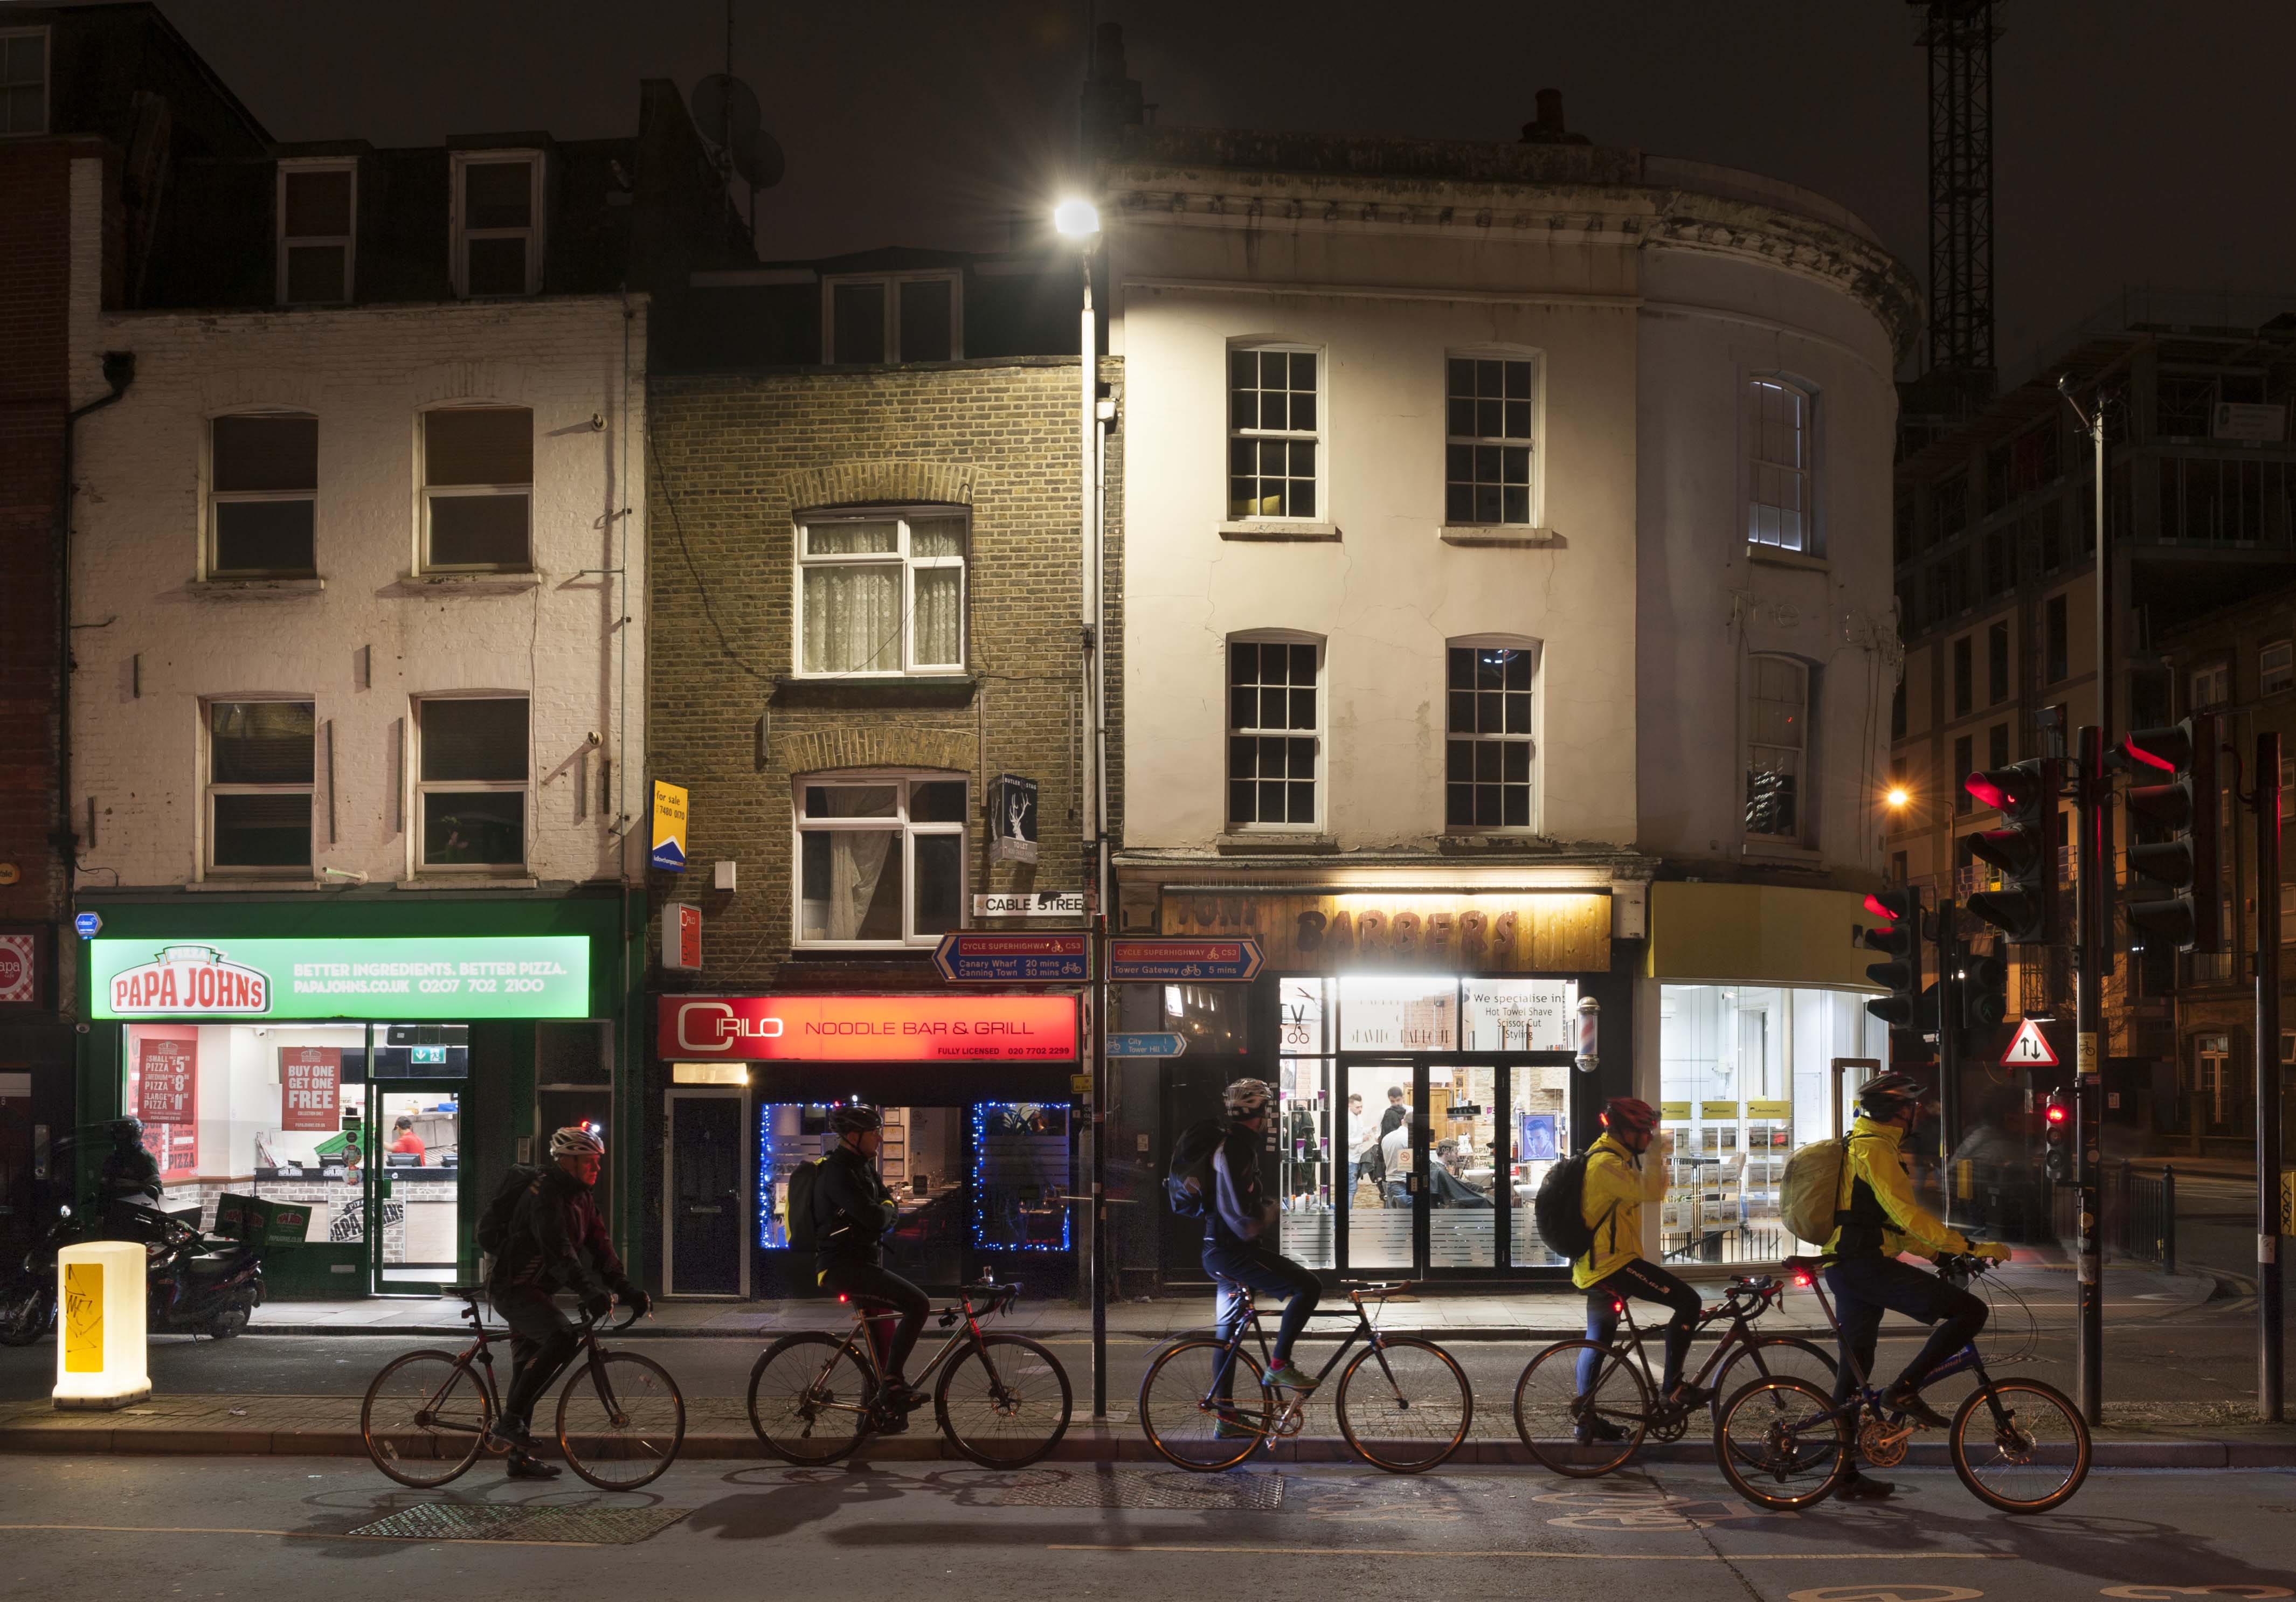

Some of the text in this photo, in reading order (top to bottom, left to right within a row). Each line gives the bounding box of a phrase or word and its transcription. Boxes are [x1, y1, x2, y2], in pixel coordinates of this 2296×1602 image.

[1005, 778, 1020, 786] BUTLER
[656, 790, 680, 806] for sale
[660, 805, 684, 820] 7480 0170
[986, 898, 1083, 911] CABLE STREE
[1297, 910, 1518, 954] BARBERS
[293, 962, 568, 976] BETTER INGREDIENTS. BETTER PIZZA.
[959, 960, 989, 969] Canary
[992, 960, 1018, 968] Wharf
[1040, 960, 1059, 968] mins
[959, 969, 993, 978] Canning
[1142, 966, 1179, 975] Gateway
[1217, 966, 1237, 974] mins
[116, 969, 178, 1007] PAPA
[293, 979, 544, 993] PAPAJOHNS.CO.UK 0207 702 2100
[1474, 994, 1490, 1003] We
[1495, 994, 1547, 1004] specialise
[1486, 1007, 1552, 1016] Hot Towel Shave
[677, 1002, 784, 1051] CIRILO
[1497, 1018, 1541, 1028] Scissor Cut
[806, 1022, 1034, 1035] NOODLE BAR & GRILL
[1506, 1030, 1533, 1040] Styling
[1025, 1047, 1046, 1055] 7702
[146, 1063, 169, 1072] PIZZA
[288, 1065, 334, 1077] BUY ONE
[144, 1081, 168, 1091] PIZZA
[289, 1078, 334, 1088] GET ONE
[289, 1090, 334, 1108] FREE
[144, 1101, 167, 1109] PIZZA
[168, 1153, 194, 1169] PIZZA
